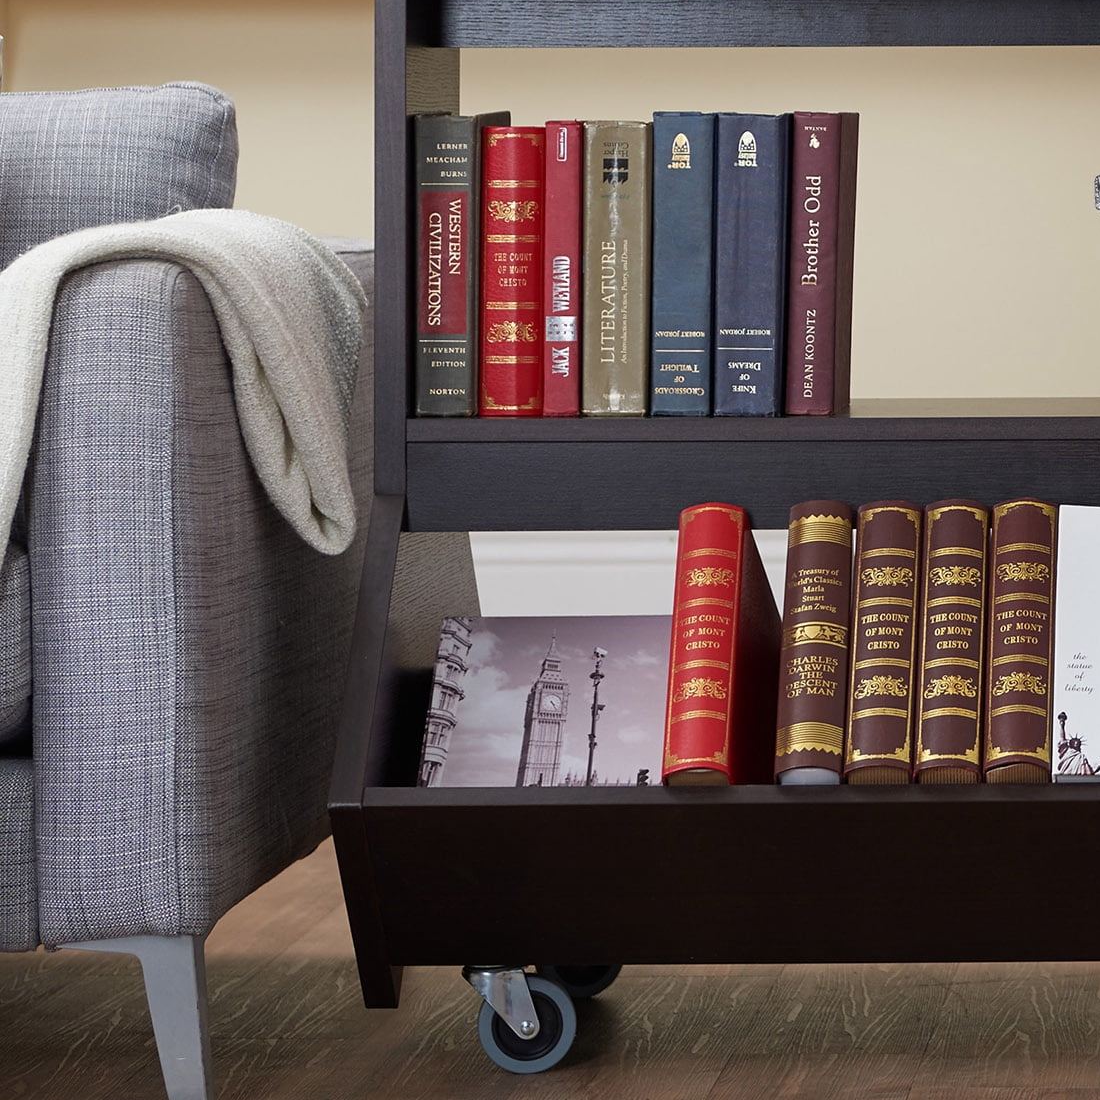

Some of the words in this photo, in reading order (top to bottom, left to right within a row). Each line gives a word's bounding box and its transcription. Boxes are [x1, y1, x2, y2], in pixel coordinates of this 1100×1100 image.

[804, 175, 821, 213] Odd
[449, 199, 462, 275] WESTERN
[494, 253, 507, 262] THE
[509, 253, 533, 262] COUNT
[802, 219, 820, 286] Brother
[428, 212, 442, 326] CIVILIZATIONS
[497, 265, 507, 274] OF
[509, 265, 529, 274] MONT
[499, 278, 527, 287] CRISTO
[552, 256, 571, 313] WEYLAND
[600, 240, 616, 363] LITERATURE
[655, 330, 680, 338] JORDAN
[719, 328, 746, 336] JORDAN
[804, 309, 817, 359] KOONTZ
[551, 346, 570, 378] JACK
[803, 364, 813, 398] DEAN
[798, 568, 829, 577] Treasury
[814, 577, 843, 586] Classics
[814, 603, 837, 614] Zweig
[680, 615, 698, 626] THE
[698, 614, 731, 625] COUNT
[861, 613, 878, 624] THE
[879, 613, 909, 623] COUNT
[930, 613, 947, 624] THE
[948, 613, 978, 623] COUNT
[996, 610, 1015, 621] THE
[1015, 609, 1048, 621] COUNT
[865, 628, 877, 637] OF
[878, 627, 904, 636] MONT
[934, 628, 947, 636] OF
[947, 627, 973, 636] MONT
[1000, 623, 1012, 632] OF
[1016, 623, 1043, 632] MONT
[683, 629, 695, 638] OF
[697, 628, 726, 637] MONT
[936, 640, 969, 650] CRISTO
[1003, 636, 1039, 644] CRISTO
[685, 641, 720, 651] CRISTO
[867, 641, 900, 650] CRISTO
[787, 655, 839, 667] CHARLES
[1073, 652, 1086, 660] the
[788, 664, 835, 675] DARWIN
[799, 671, 823, 679] THE
[1074, 672, 1085, 681] of
[786, 679, 838, 690] DESCENT
[1064, 684, 1094, 694] liberty
[787, 688, 802, 698] OF
[806, 687, 834, 696] MAN
